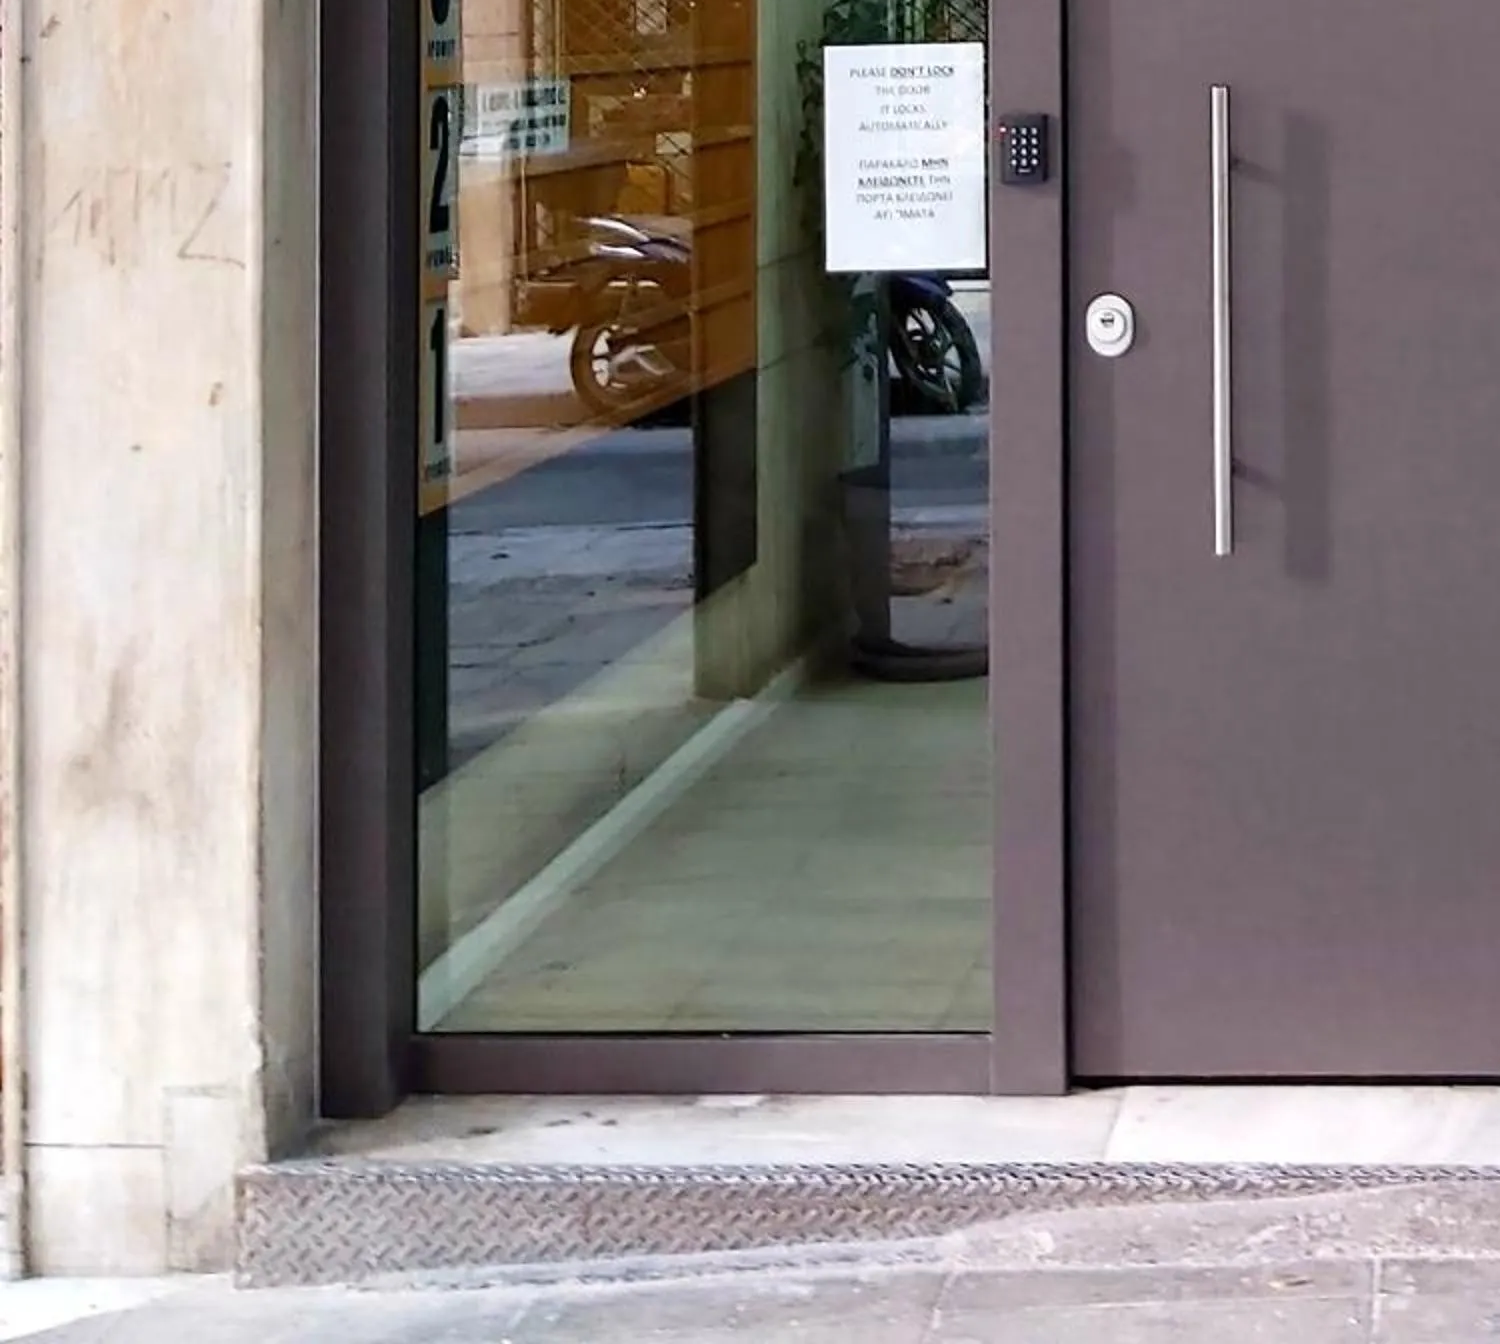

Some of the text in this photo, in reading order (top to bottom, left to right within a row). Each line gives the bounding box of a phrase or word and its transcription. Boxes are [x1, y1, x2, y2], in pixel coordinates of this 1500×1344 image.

[850, 64, 955, 78] PLEASE DON'T LOCK
[876, 84, 931, 96] THE DOOR
[894, 103, 926, 114] LOCKS
[859, 120, 948, 133] AUTOMATICALLY
[430, 96, 450, 233] 2
[429, 308, 444, 444] 1
